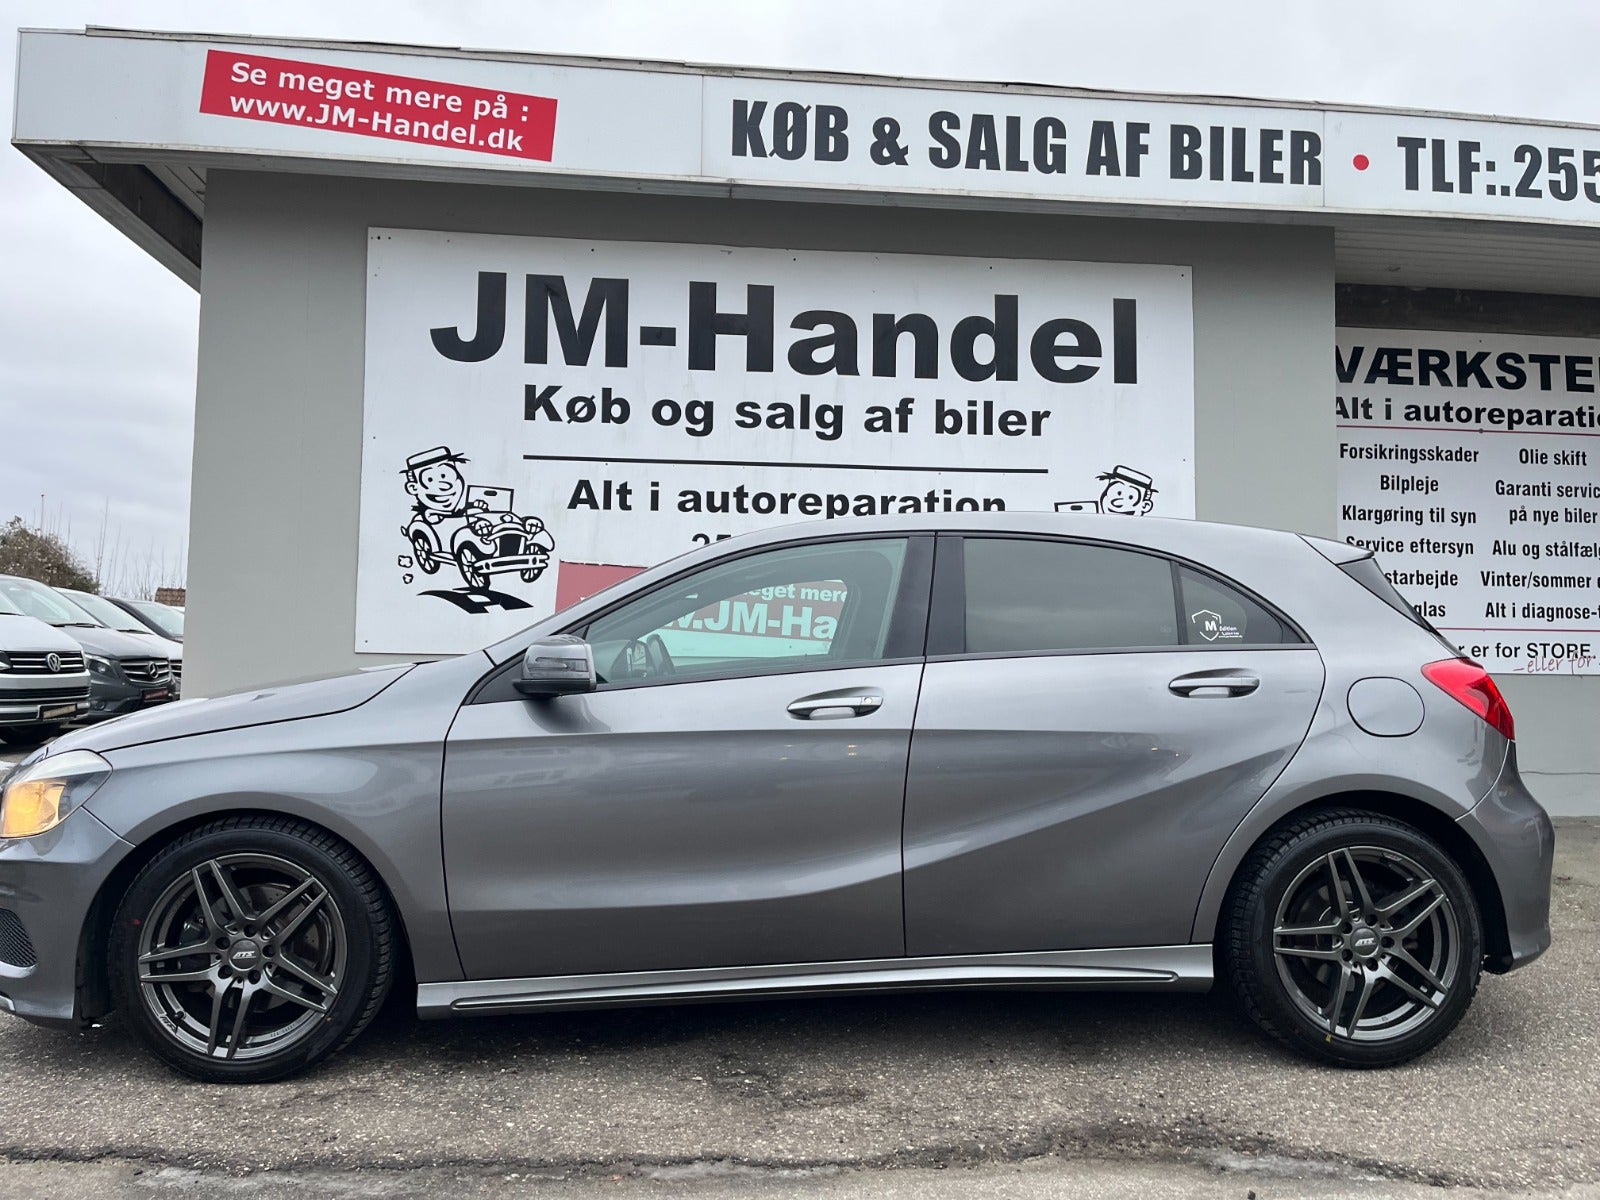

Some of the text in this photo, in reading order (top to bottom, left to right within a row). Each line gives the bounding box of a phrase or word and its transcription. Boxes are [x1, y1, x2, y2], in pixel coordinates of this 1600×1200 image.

[231, 62, 267, 86] Se
[279, 72, 375, 100] meget
[386, 86, 462, 113] mere
[473, 94, 508, 120] på
[230, 95, 523, 151] www.JM-Handel.dk
[732, 99, 849, 162] KØB
[870, 117, 909, 166] &
[928, 110, 1066, 174] SALG
[1086, 120, 1150, 177] AF
[1170, 124, 1322, 186] BILER
[430, 271, 1137, 384] JM-Handel
[1336, 345, 1600, 393] VÆRKSTE
[524, 384, 1051, 441] Køb og salg af biler
[1336, 396, 1373, 420] Alt
[1385, 398, 1392, 420] i
[1340, 443, 1479, 463] Forsikringsskader
[1519, 449, 1587, 466] Olie skift
[1380, 475, 1439, 494] Bilpleje
[1495, 479, 1551, 497] Garanti
[567, 479, 1006, 520] Alt i autoreparation
[1342, 505, 1476, 526] Klargøring til syn
[1509, 506, 1598, 525] på nye biler
[1410, 538, 1474, 557] eftersyn
[1492, 540, 1600, 560] Alu og stålfæl
[1481, 571, 1591, 589] Vinter/sommer
[744, 584, 795, 600] get
[1485, 603, 1506, 618] Alt
[1512, 603, 1516, 618] i
[1205, 621, 1217, 631] M
[1471, 647, 1489, 657] er
[1495, 643, 1520, 657] for
